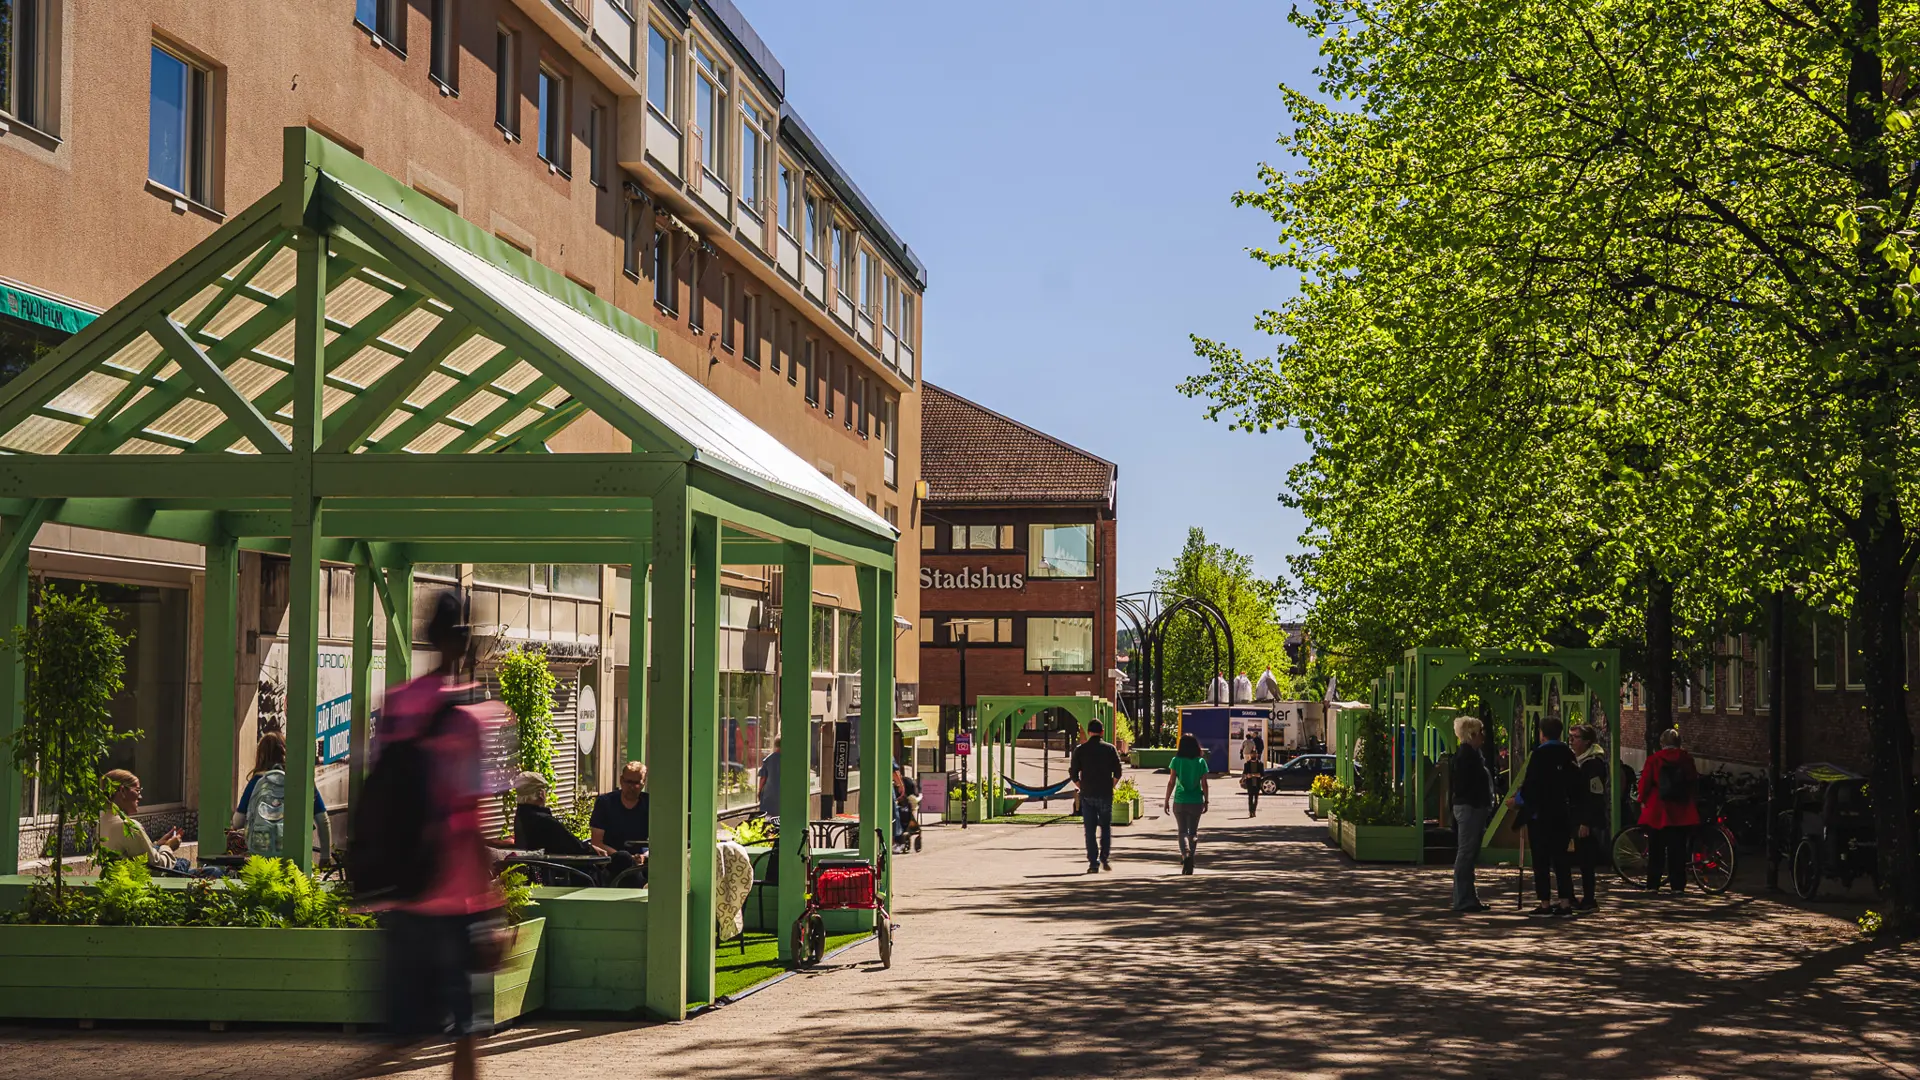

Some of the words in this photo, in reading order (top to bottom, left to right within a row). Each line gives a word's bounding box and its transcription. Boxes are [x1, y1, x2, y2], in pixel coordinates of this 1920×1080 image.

[21, 299, 64, 325] FUJIFILM
[920, 566, 1023, 589] Stadshus
[318, 705, 329, 733] HÄR
